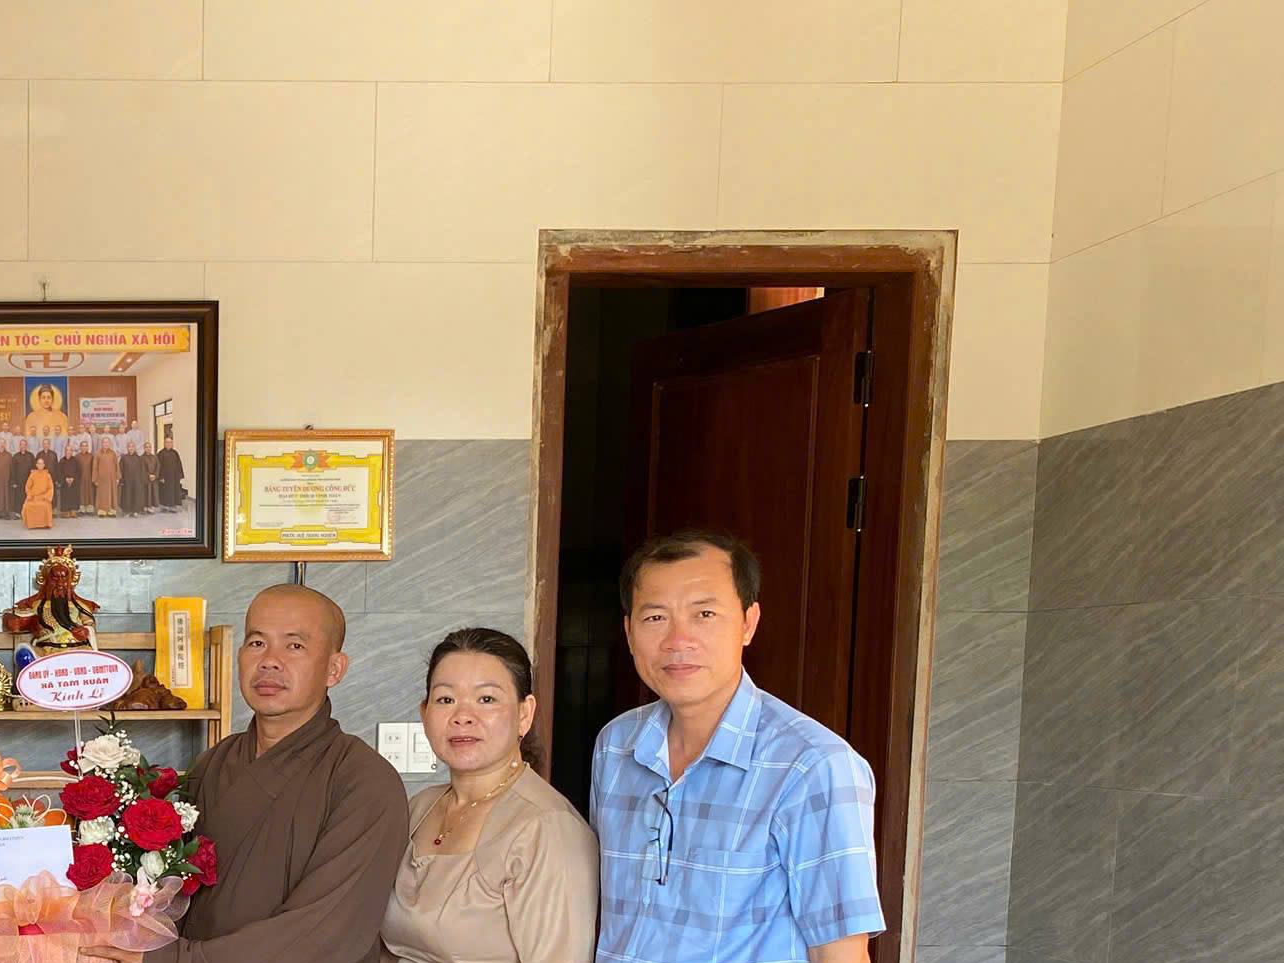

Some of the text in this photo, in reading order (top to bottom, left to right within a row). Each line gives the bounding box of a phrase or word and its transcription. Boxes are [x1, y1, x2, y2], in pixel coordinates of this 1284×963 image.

[15, 332, 40, 348] TỘC
[54, 330, 81, 345] CHỦ
[58, 680, 79, 688] TAM
